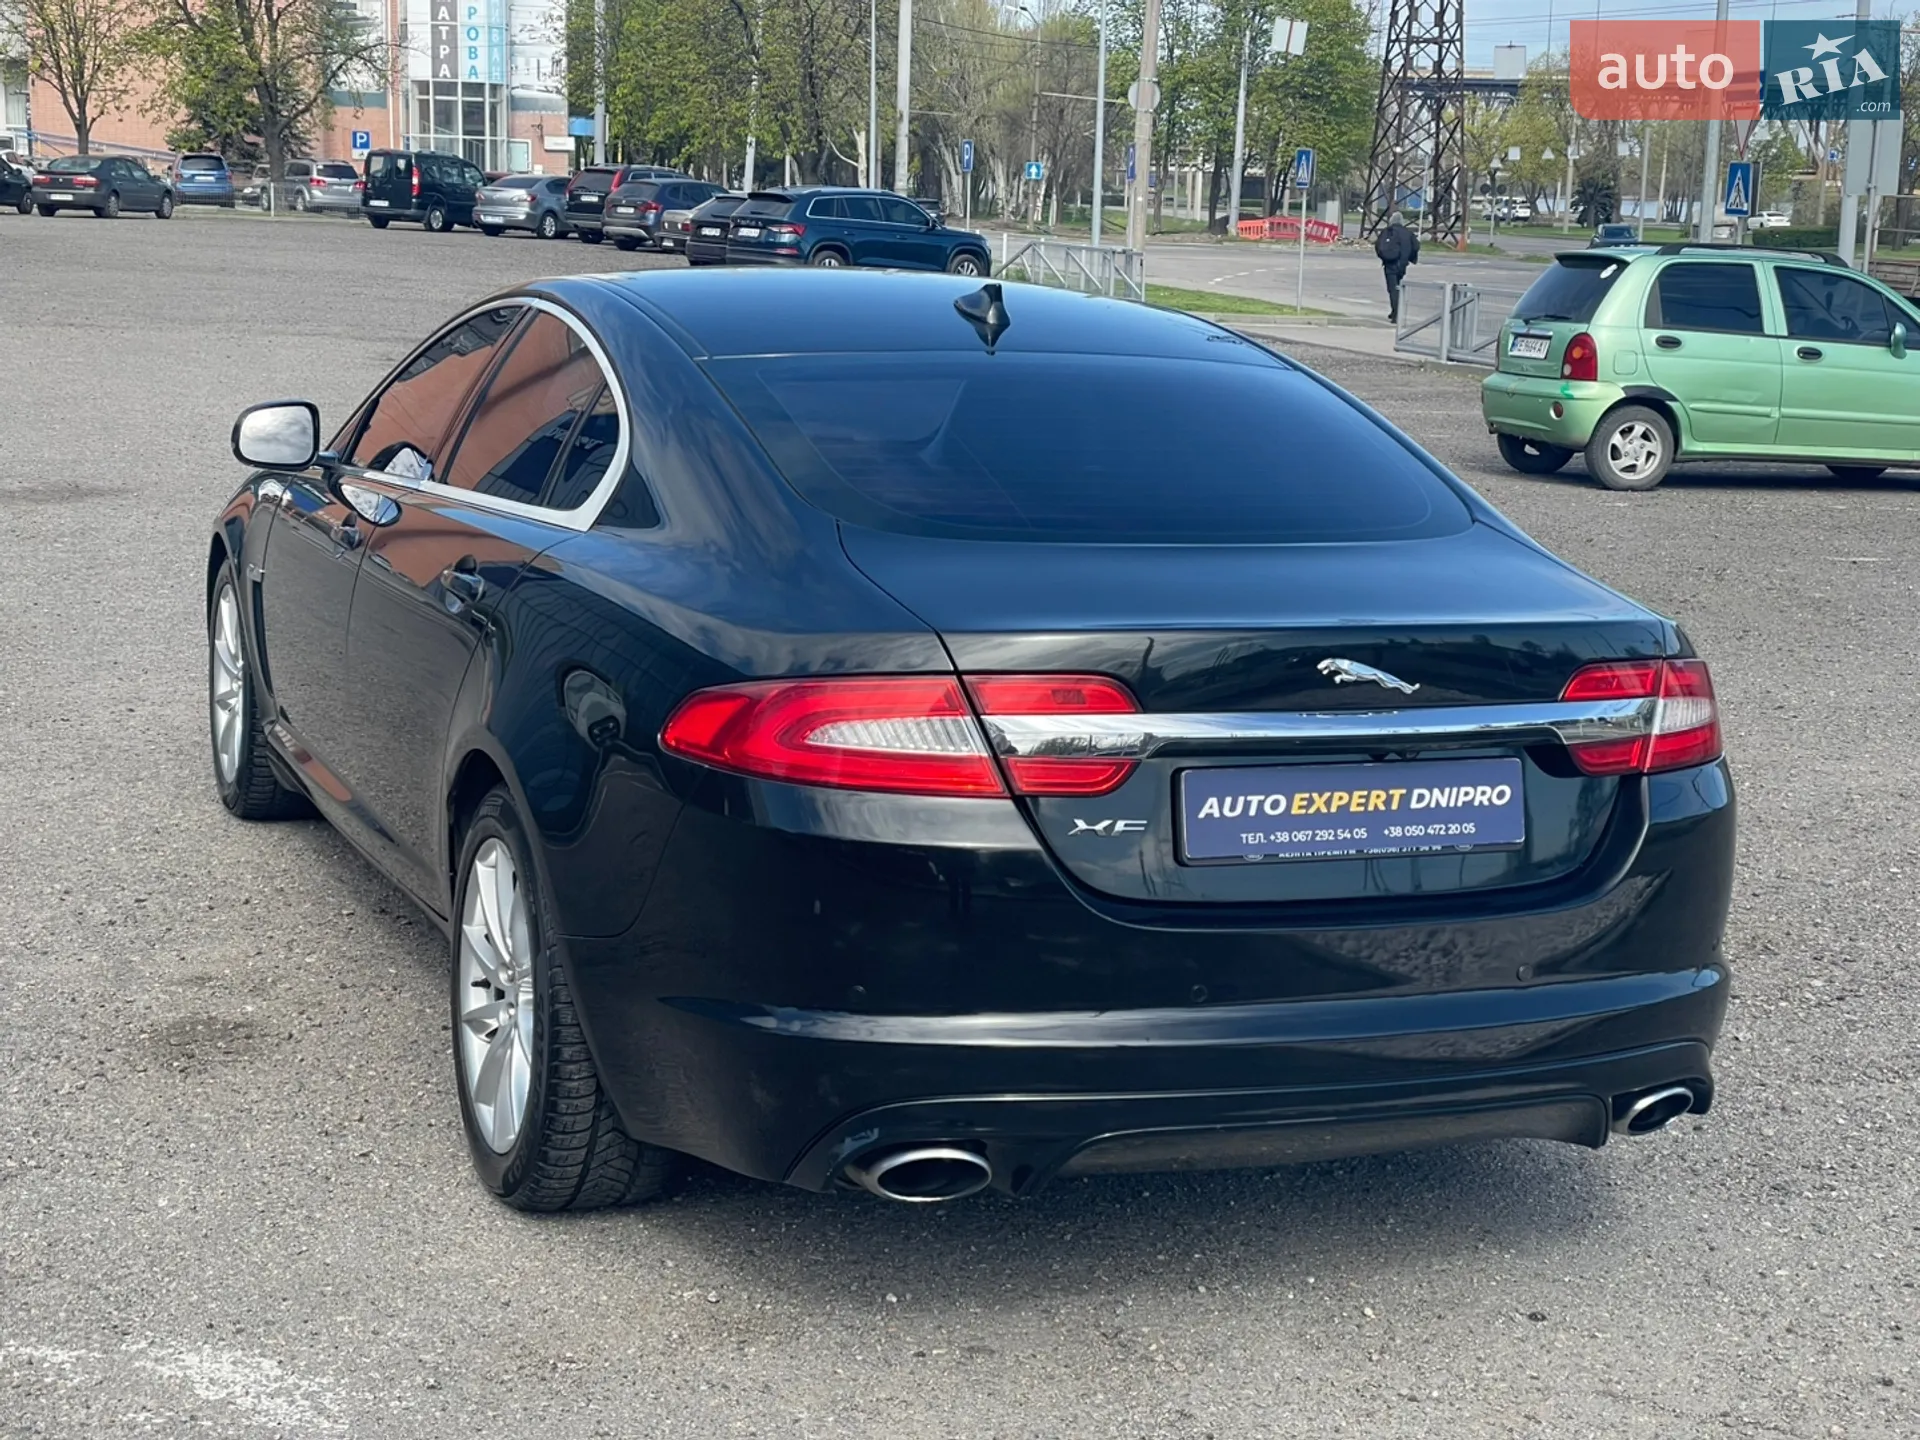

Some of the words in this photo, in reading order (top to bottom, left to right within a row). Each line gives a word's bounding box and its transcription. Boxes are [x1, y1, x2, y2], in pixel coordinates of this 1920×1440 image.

[437, 0, 452, 78] АТРА
[466, 0, 480, 79] РОВА
[356, 132, 367, 148] P
[1197, 794, 1287, 819] AUTO
[1290, 789, 1407, 815] EXPERT
[1410, 784, 1512, 810] DNIPRO
[1067, 818, 1148, 837] XF
[1240, 833, 1267, 844] ТЕЛ.
[1269, 831, 1289, 843] +38
[1291, 830, 1313, 842] 067
[1315, 829, 1335, 841] 292
[1336, 828, 1351, 840] 54
[1353, 828, 1367, 839] 05
[1383, 826, 1403, 837] +38
[1404, 825, 1425, 836] 050
[1427, 824, 1446, 835] 472
[1447, 823, 1461, 834] 20
[1462, 822, 1476, 834] 05
